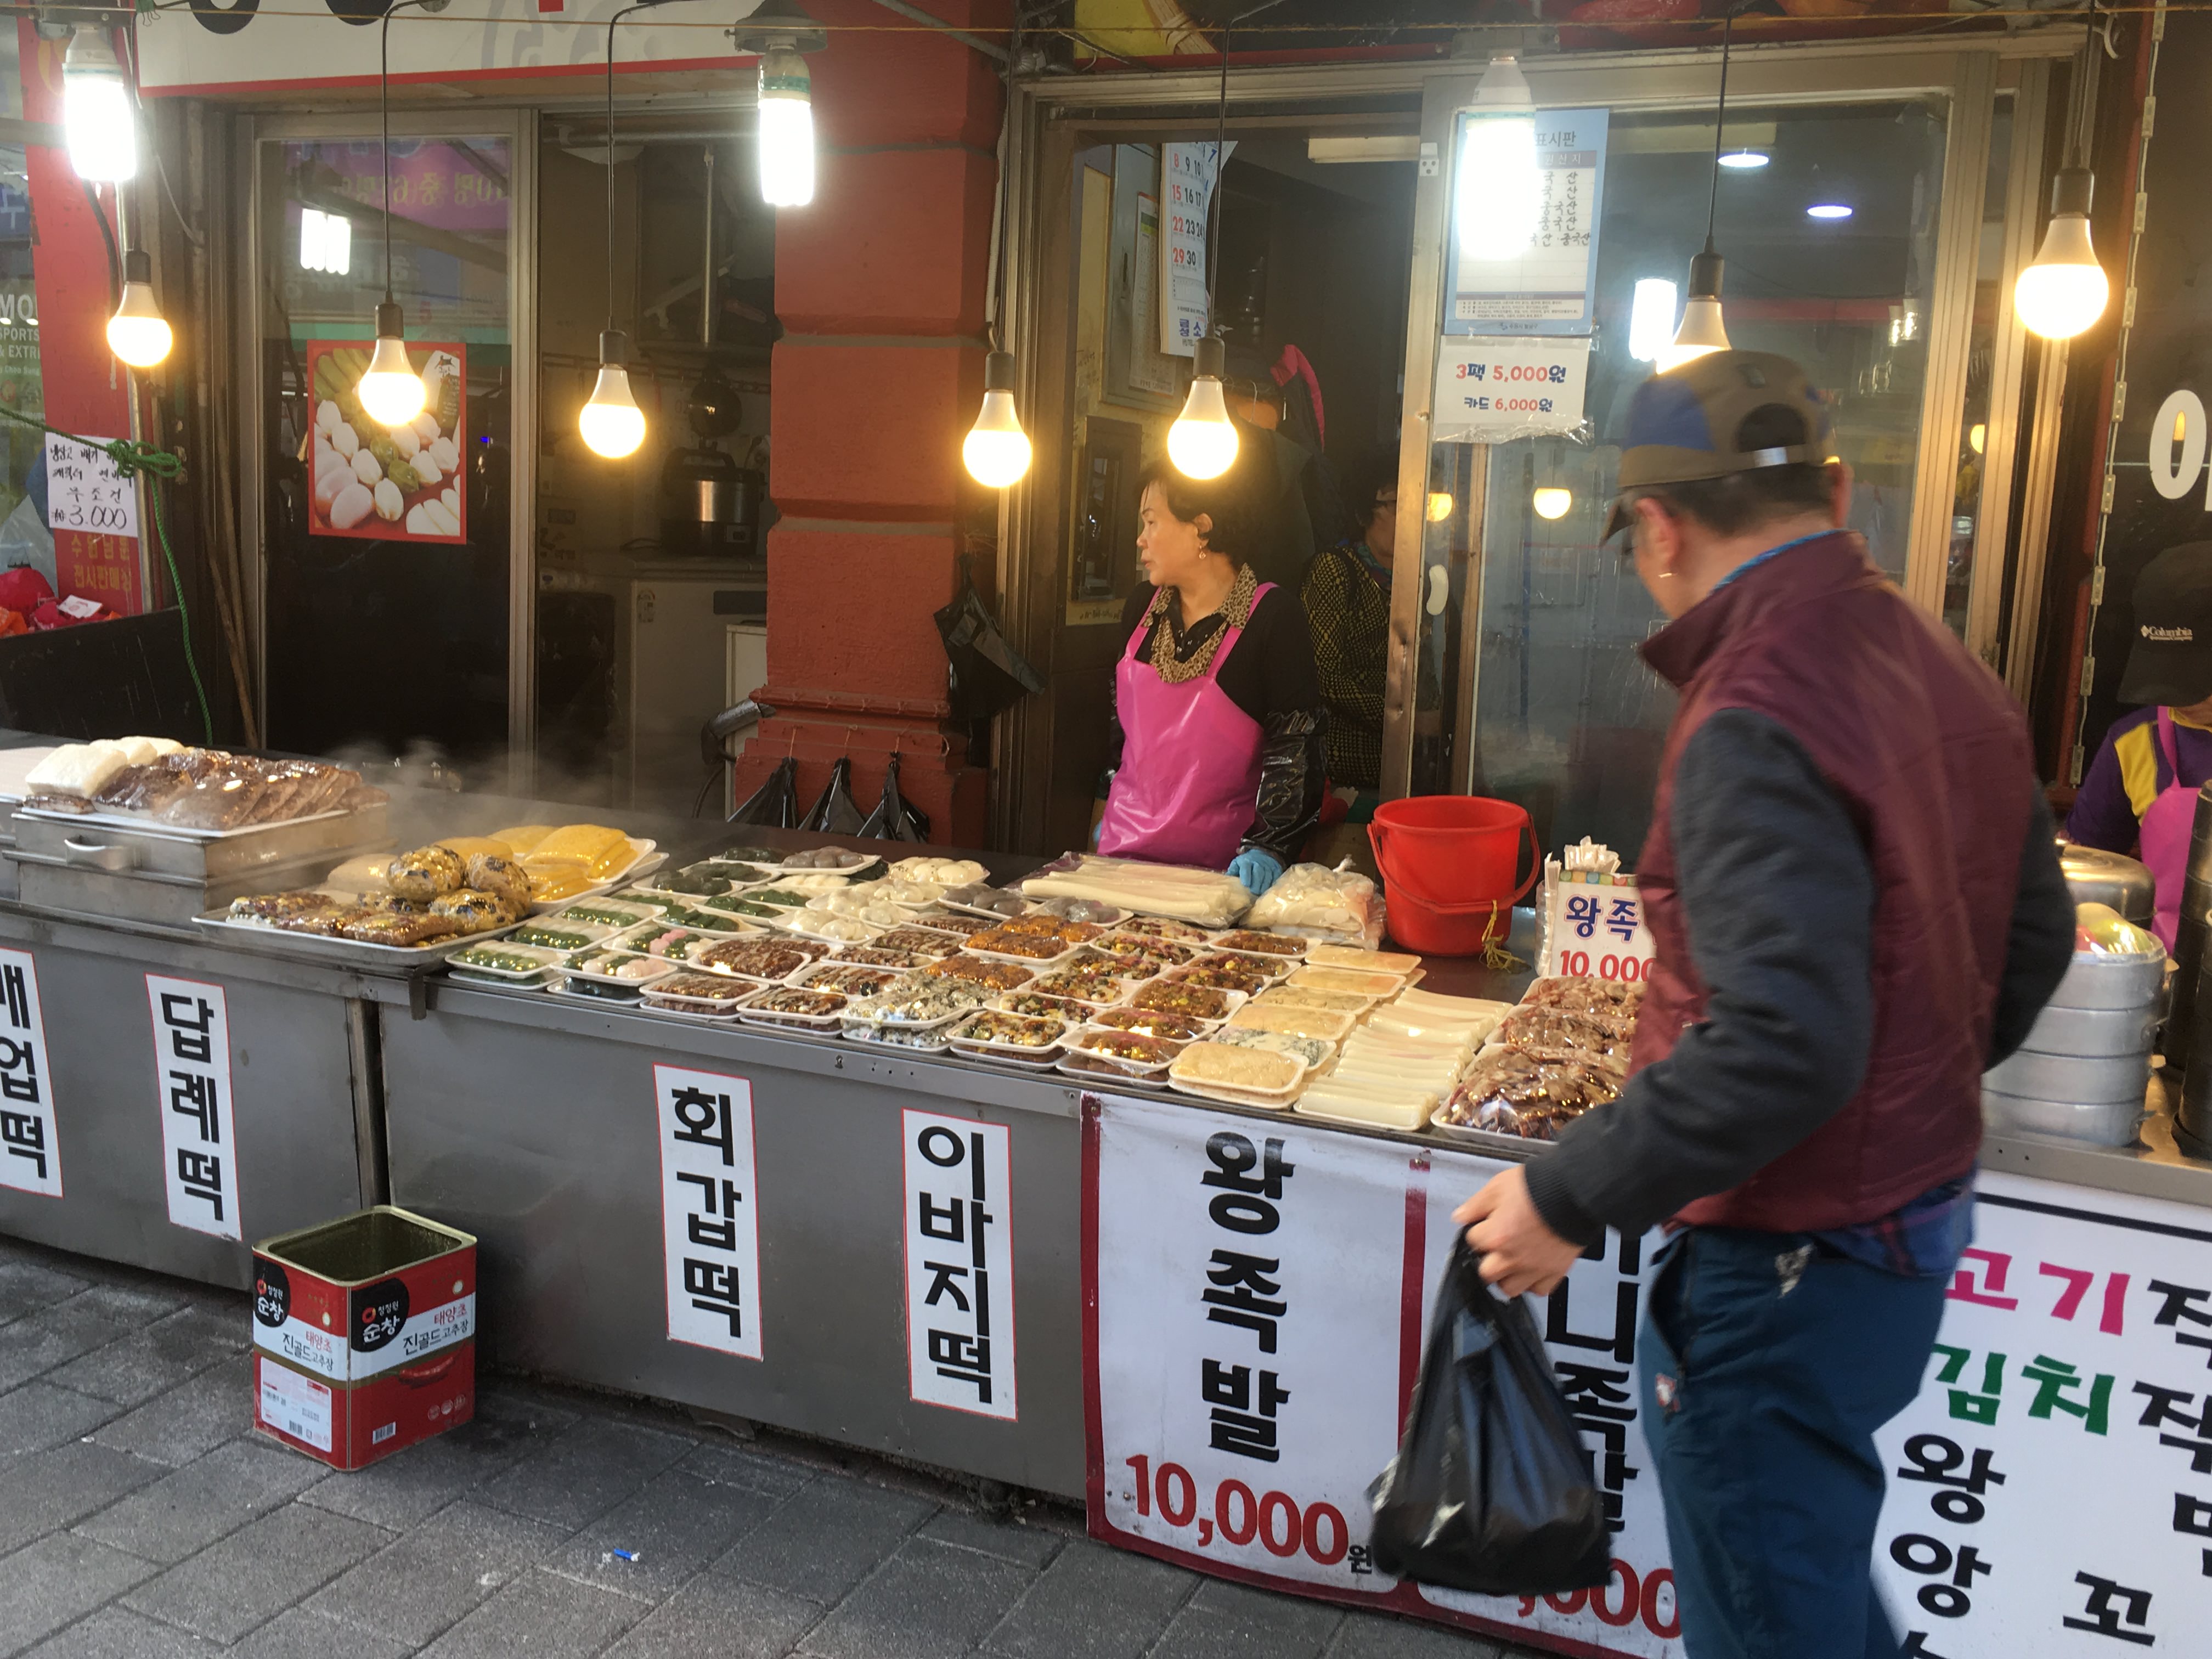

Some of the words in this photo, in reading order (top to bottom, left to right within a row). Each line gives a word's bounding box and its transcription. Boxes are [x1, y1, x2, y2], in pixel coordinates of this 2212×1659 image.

[1174, 153, 1179, 168] 8
[1186, 156, 1190, 172] 9
[1194, 160, 1200, 177] 10
[1208, 149, 1217, 162] 7
[1172, 184, 1181, 201] 15
[1185, 188, 1193, 204] 16
[1195, 191, 1201, 207] 17
[1172, 216, 1183, 233] 22
[1186, 218, 1195, 235] 23
[1197, 222, 1203, 238] 24
[1172, 247, 1184, 264] 29
[1187, 250, 1196, 266] 30
[0, 294, 38, 320] MO
[9, 345, 40, 359] EXTR
[1456, 363, 1486, 381] 3팩
[1492, 365, 1566, 383] 5,000원
[1464, 397, 1489, 410] 카드
[1495, 398, 1553, 412] 6,000원
[1565, 895, 1656, 943] 왕족
[160, 992, 224, 1222] 답례떡
[672, 1087, 742, 1339] 회갑떡
[917, 1125, 994, 1404] 이바지떡
[258, 1296, 284, 1322] 순창
[1199, 1131, 1295, 1463] 왕족발
[363, 1314, 400, 1344] 순창
